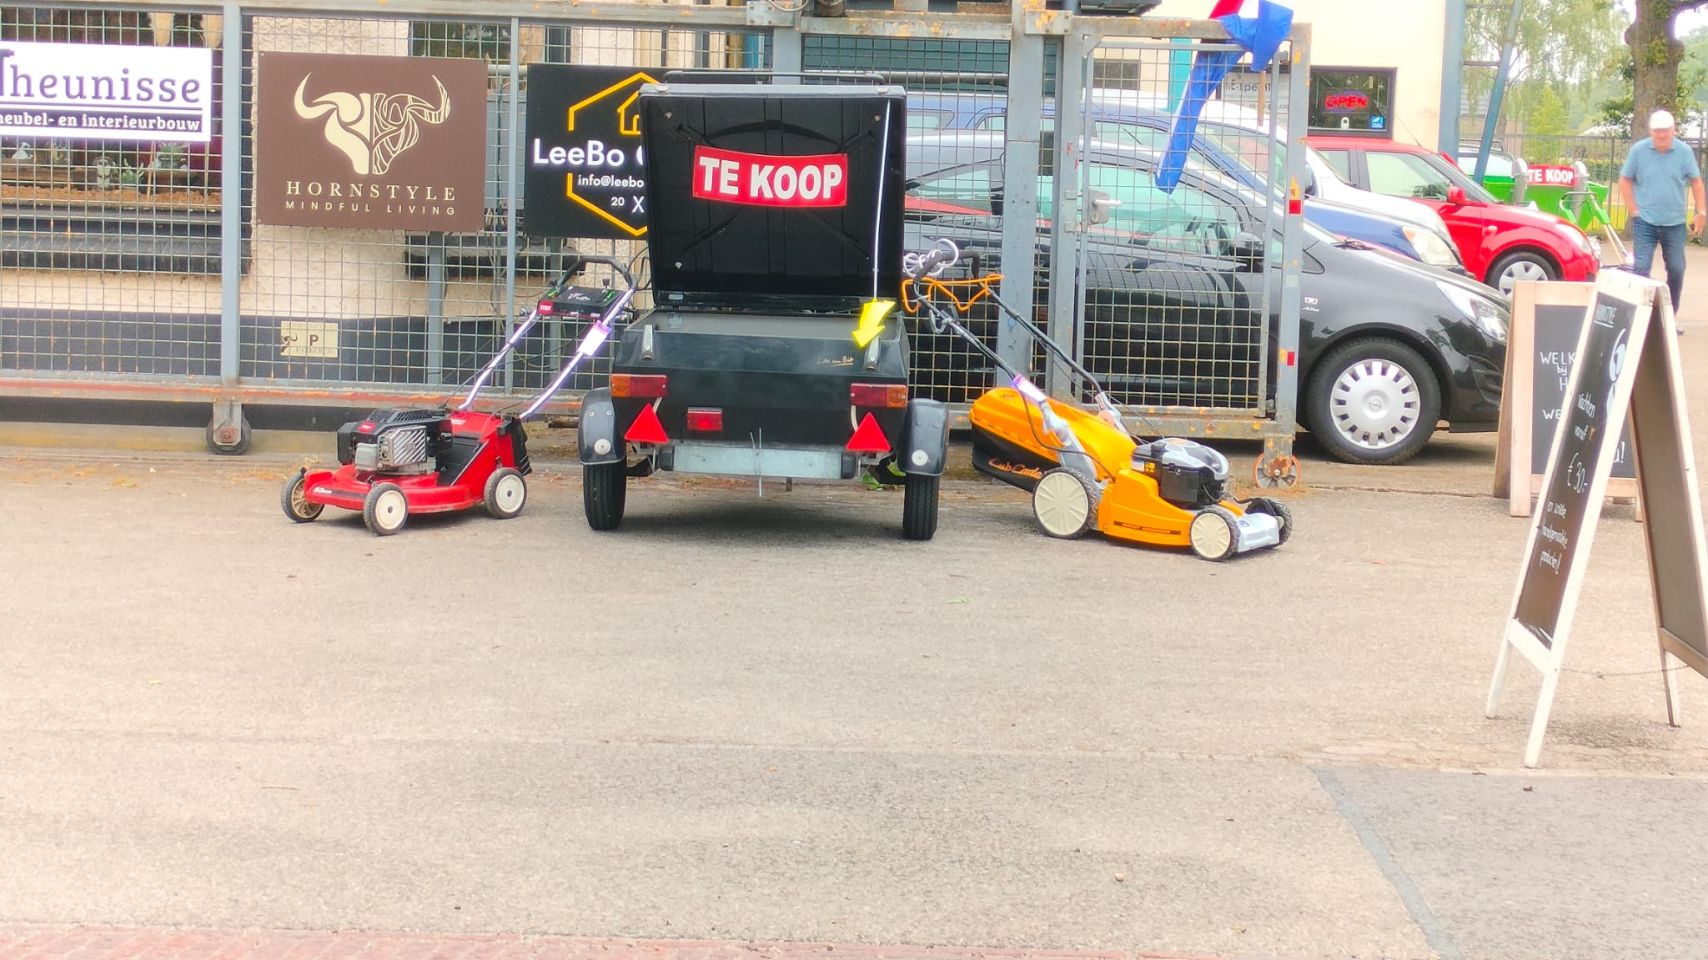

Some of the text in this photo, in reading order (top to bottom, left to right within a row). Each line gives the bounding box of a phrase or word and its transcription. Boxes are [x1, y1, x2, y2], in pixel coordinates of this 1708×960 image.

[59, 115, 77, 126] en
[82, 113, 200, 131] interieurbouw
[534, 138, 625, 166] LeeBo
[699, 156, 843, 200] TE KOOP
[1528, 168, 1574, 184] TE KOOP
[286, 181, 456, 201] HORNSTYLE
[286, 201, 455, 216] MINDFUL LIVING
[611, 197, 625, 206] 20
[309, 334, 319, 347] P
